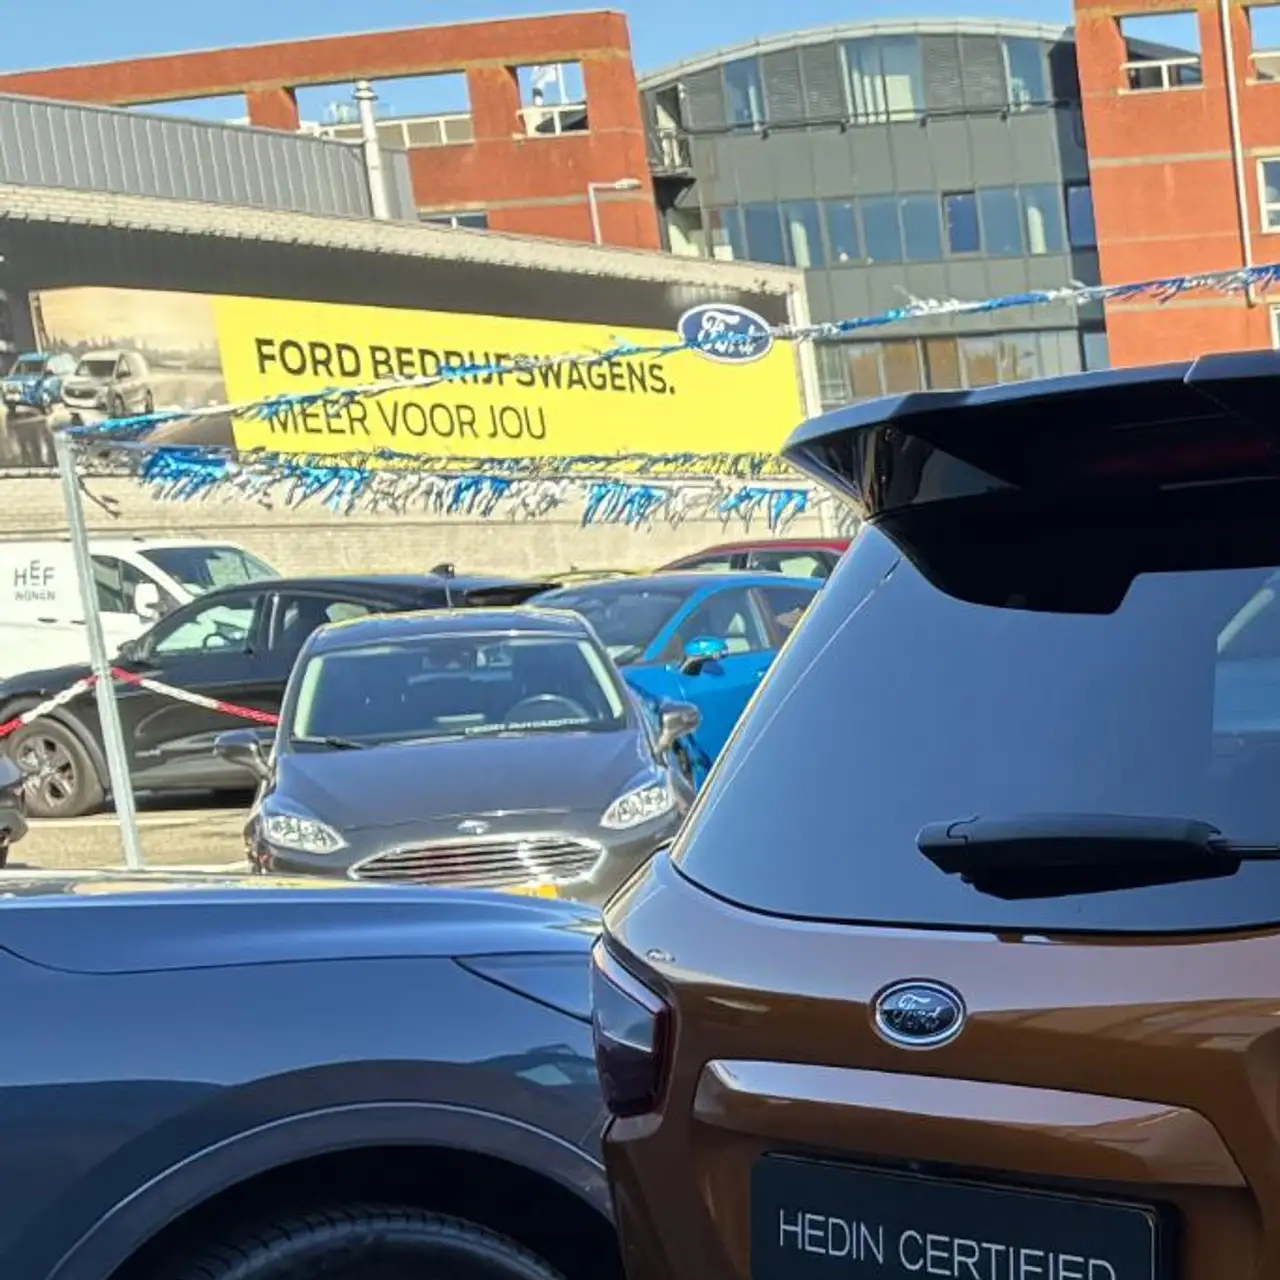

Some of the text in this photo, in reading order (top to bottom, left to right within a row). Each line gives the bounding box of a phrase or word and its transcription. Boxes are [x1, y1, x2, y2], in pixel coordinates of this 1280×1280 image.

[255, 338, 362, 378] FORD
[375, 400, 479, 438] VOOR
[488, 404, 547, 440] JOU
[14, 560, 56, 587] HEF
[779, 1209, 884, 1264] HEDIN
